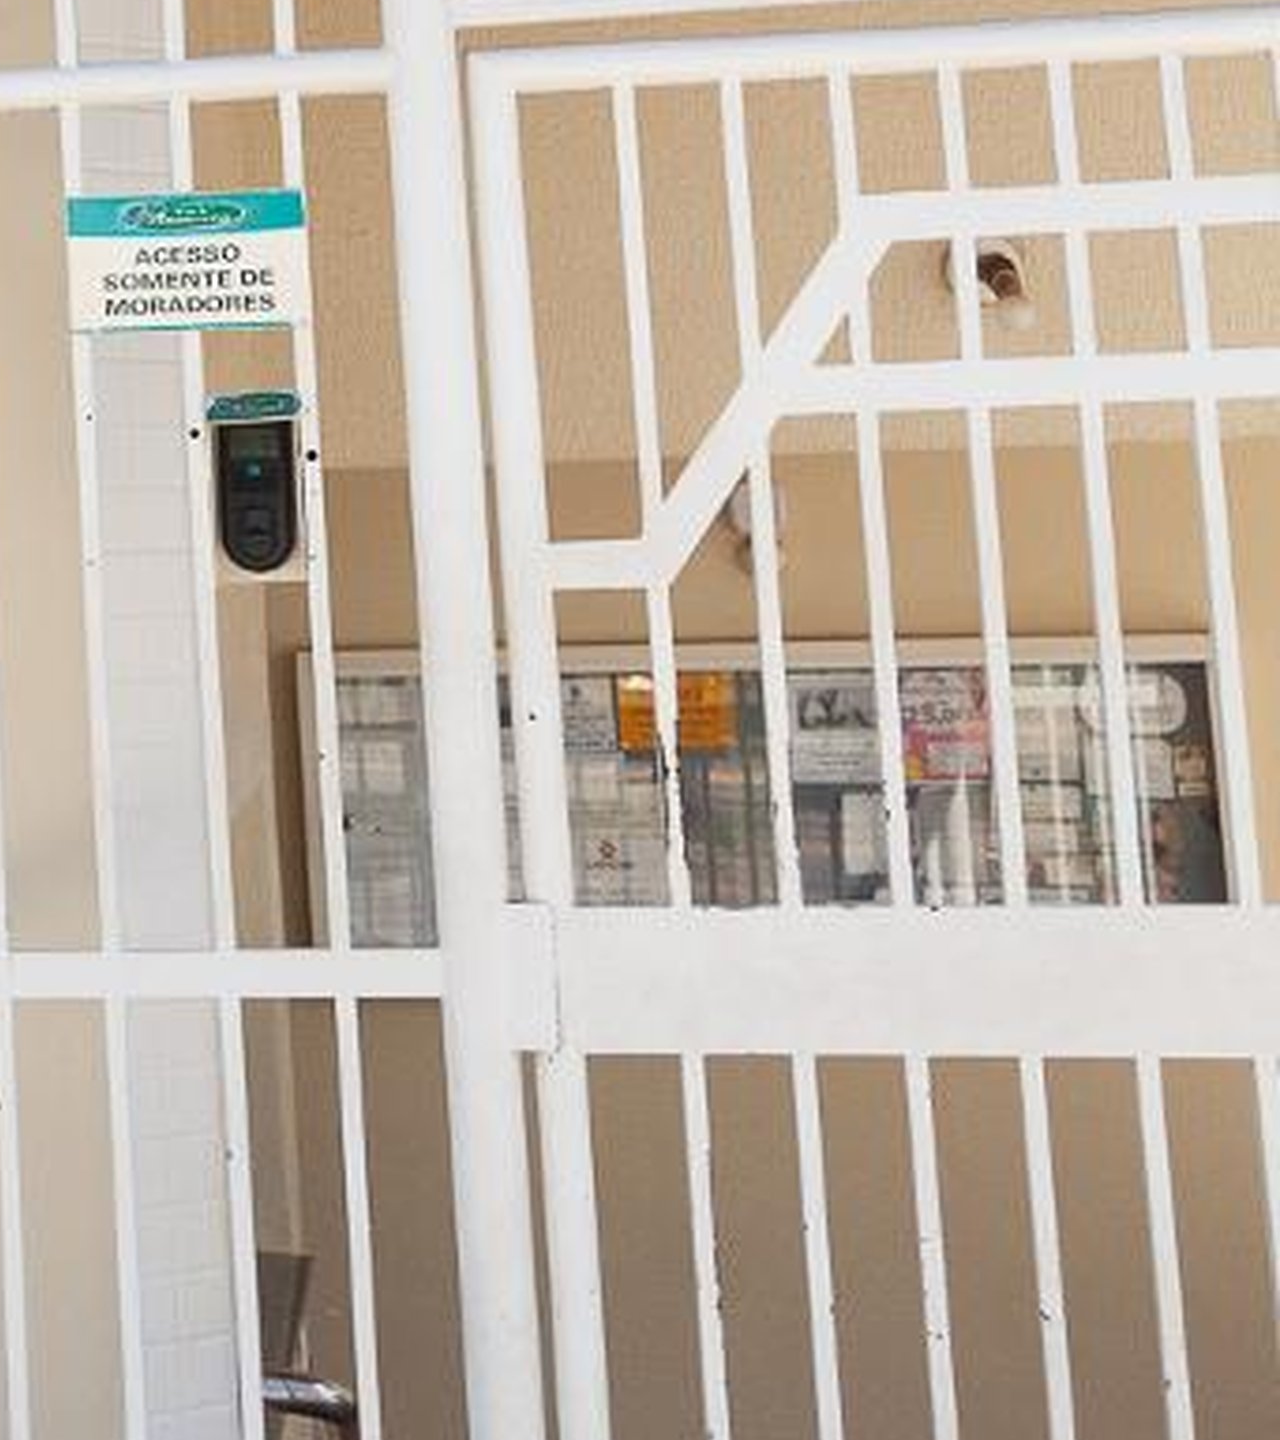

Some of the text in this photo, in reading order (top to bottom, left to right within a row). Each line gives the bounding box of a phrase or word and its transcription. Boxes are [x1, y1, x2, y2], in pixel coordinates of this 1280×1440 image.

[135, 242, 240, 265] ACESSO
[102, 269, 276, 292] SOMENTE DE
[104, 293, 277, 317] MORADORES
